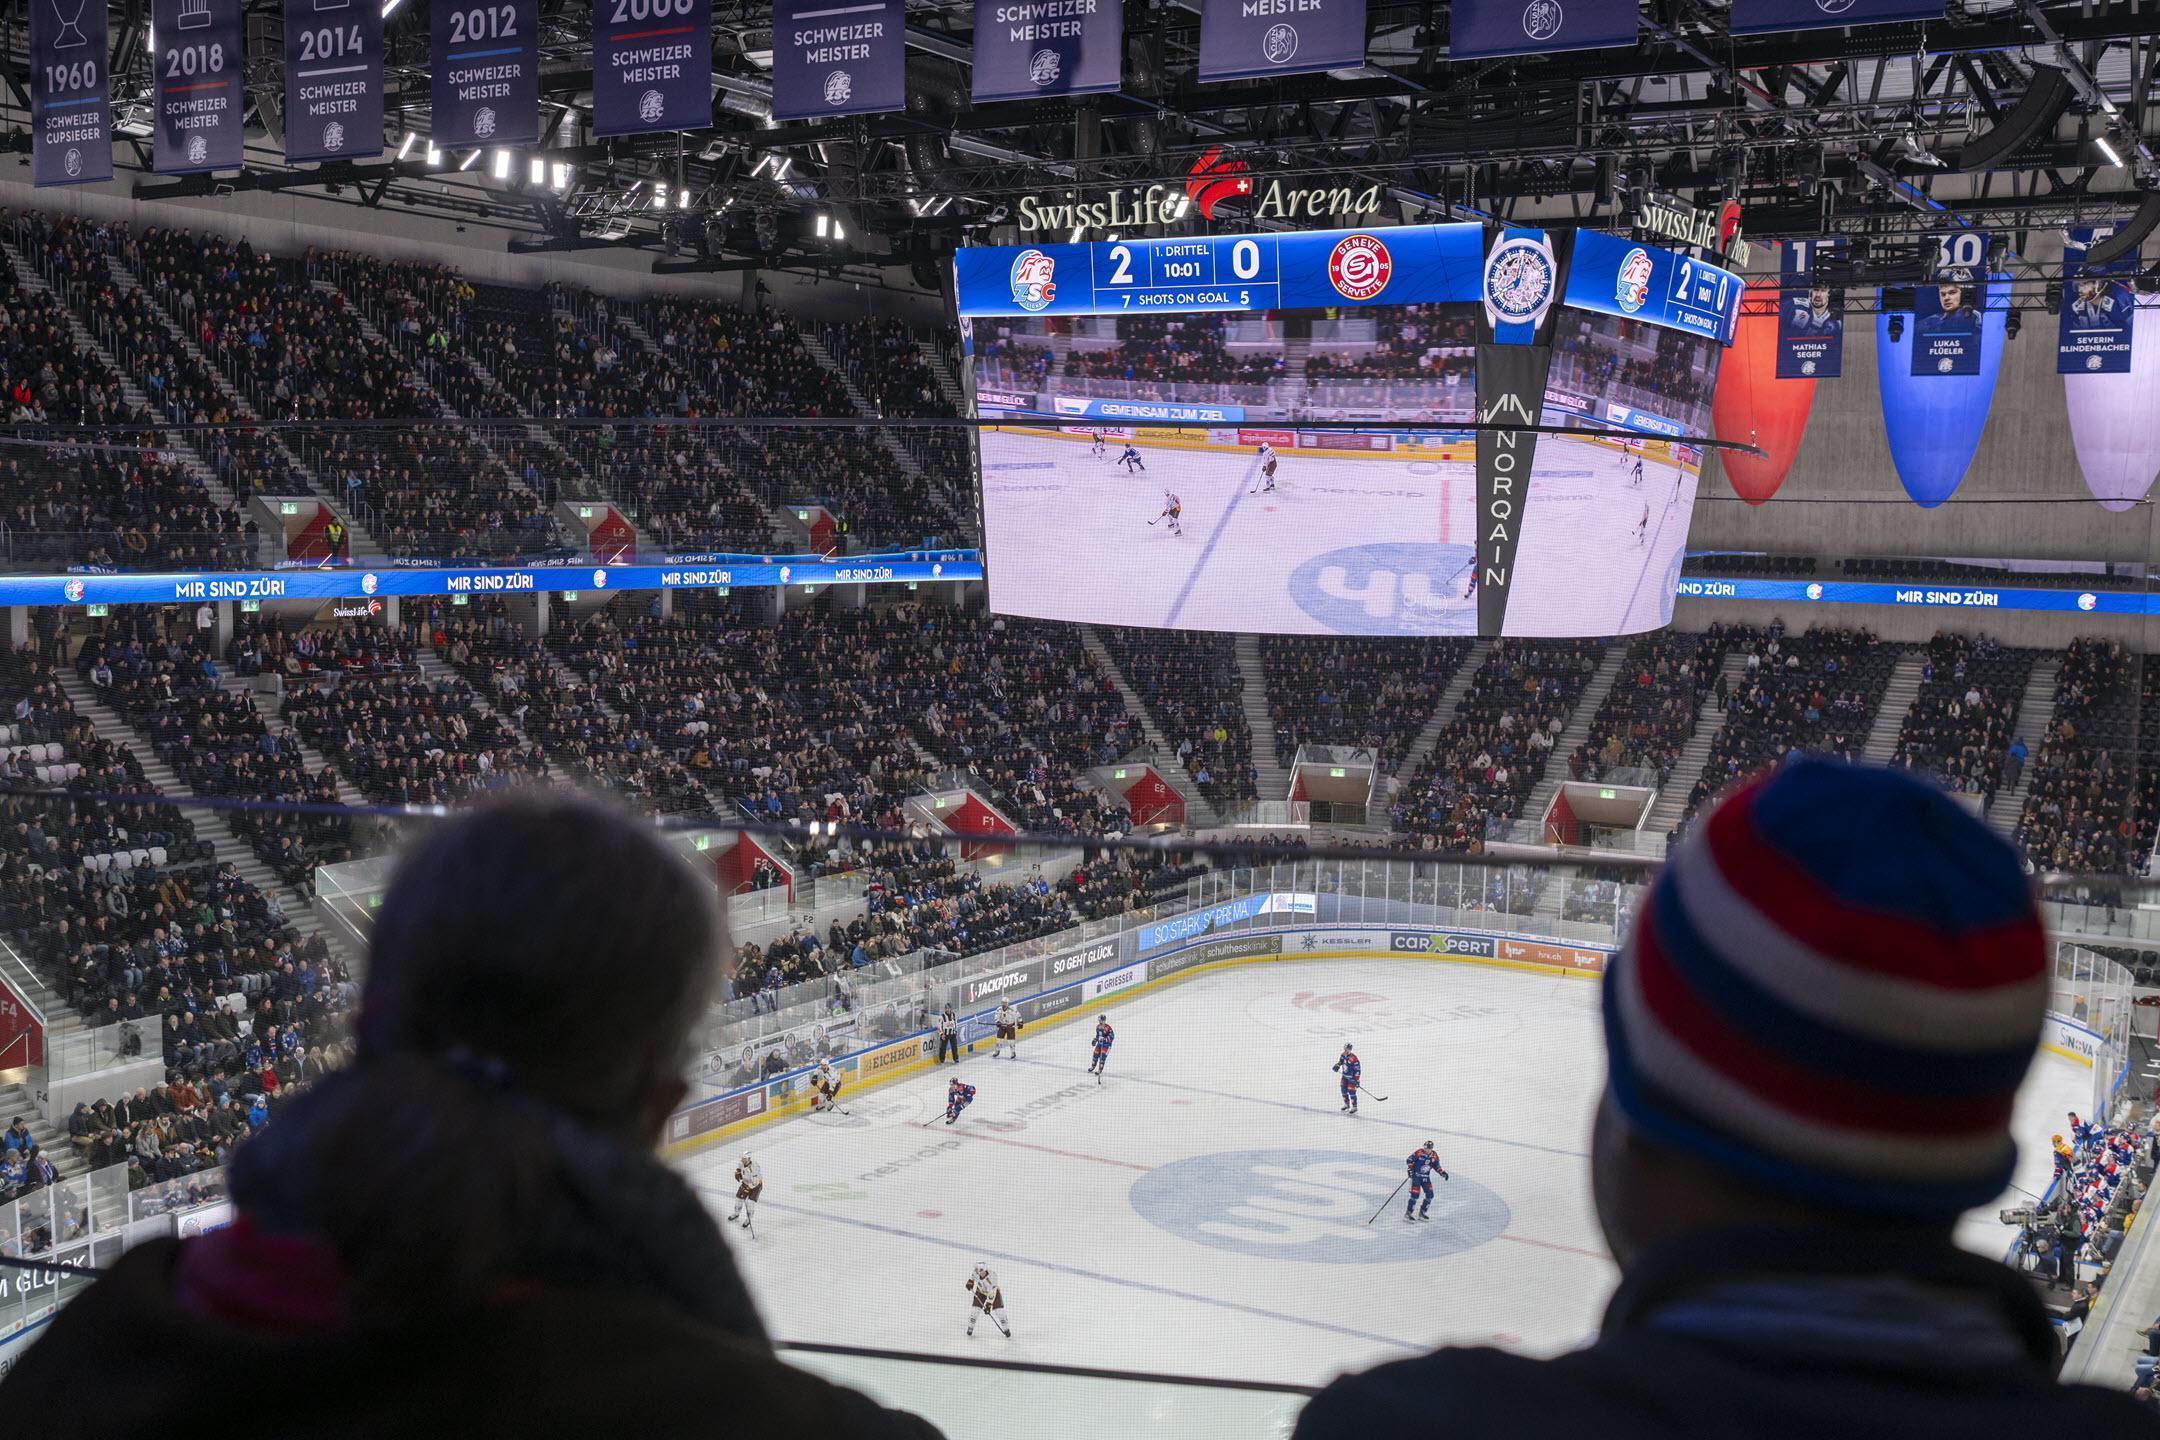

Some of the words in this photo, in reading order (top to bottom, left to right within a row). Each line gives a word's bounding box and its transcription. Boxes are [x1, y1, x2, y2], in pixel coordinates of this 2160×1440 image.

[995, 0, 1097, 23] SCHWEIZER
[1243, 0, 1321, 17] MEISTER
[449, 6, 517, 44] 2012
[793, 22, 884, 47] SCHWEIZER
[1009, 20, 1082, 42] MEISTER
[299, 25, 363, 61] 2014
[166, 43, 224, 78] 2018
[611, 43, 693, 67] SCHWEIZER
[805, 43, 870, 65] MEISTER
[46, 60, 97, 93] 1960
[448, 63, 521, 85] SCHWEIZER
[622, 63, 681, 84] MEISTER
[300, 81, 367, 100] SCHWEIZER
[458, 82, 511, 101] MEISTER
[166, 97, 227, 115] SCHWEIZER
[309, 99, 357, 115] MEISTER
[46, 111, 100, 129] SCHWEIZER
[175, 114, 219, 130] MEISTER
[46, 127, 100, 145] CUPSIEGER
[1255, 179, 1381, 220] Arena
[1155, 247, 1163, 257] 1.
[1166, 245, 1209, 257] DRITTEL
[1338, 238, 1381, 255] GENEVE
[1109, 246, 1133, 284] 2
[1232, 240, 1260, 279] 0
[1164, 263, 1200, 278] 10:01
[1337, 279, 1383, 297] SERVETTE
[1676, 262, 1691, 300] 2
[1012, 283, 1056, 303] ZSC
[1122, 295, 1131, 309] 7
[1139, 294, 1175, 306] SHOTS
[1176, 293, 1195, 304] ON
[1197, 292, 1229, 303] GOAL
[1240, 291, 1249, 304] 5
[1614, 282, 1648, 305] ZSC
[1717, 275, 1727, 311] 0
[1677, 311, 1682, 323] 7
[1713, 321, 1718, 334] 5
[1792, 343, 1827, 351] MATHIAS
[1933, 339, 1960, 348] LUKAS
[2060, 343, 2130, 353] BLINDENBACHER
[2077, 335, 2114, 345] SEVERIN
[1929, 346, 1964, 356] FLÜELER
[1101, 404, 1168, 418] GEMEINSAM
[1485, 430, 1517, 586] NORQAIN
[613, 528, 625, 537] L2
[448, 576, 471, 591] MIR
[473, 575, 503, 590] SIND
[505, 572, 533, 589] ZÜRI
[662, 573, 681, 585] MIR
[682, 572, 707, 584] SIND
[708, 569, 731, 583] ZÜRI
[835, 570, 851, 580] MIR
[852, 569, 873, 579] SIND
[873, 566, 893, 579] ZÜRI
[176, 582, 205, 598] MIR
[209, 581, 247, 597] SIND
[249, 577, 285, 597] ZÜRI
[1704, 580, 1735, 596] ZÜRI
[1896, 590, 1924, 603] MIR
[1926, 591, 1961, 605] SIND
[1963, 590, 1998, 606] ZÜRI
[1154, 783, 1166, 793] E2
[982, 816, 995, 826] F1
[803, 915, 814, 923] F2
[1155, 926, 1169, 944] SO
[1169, 916, 1201, 940] STARK
[1054, 960, 1065, 974] SO
[1066, 954, 1088, 969] GEHT
[1104, 971, 1133, 990] GRIESSER
[1, 1001, 18, 1017] F4
[873, 1044, 918, 1069] EICHHOF
[36, 1090, 48, 1102] F4
